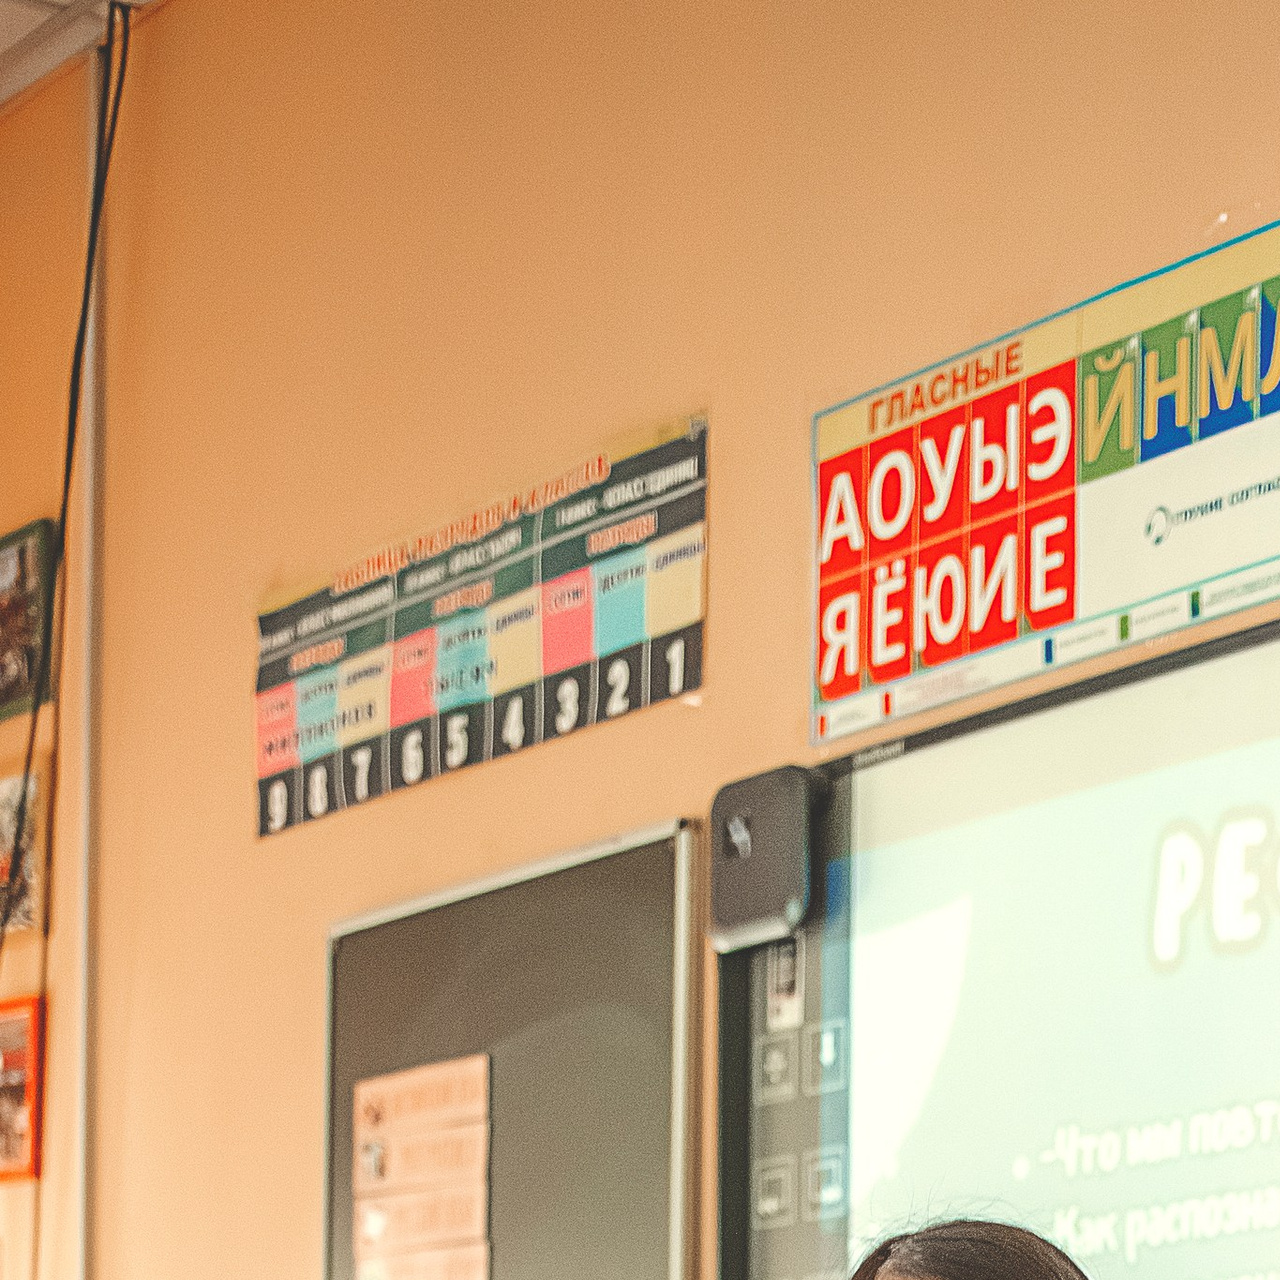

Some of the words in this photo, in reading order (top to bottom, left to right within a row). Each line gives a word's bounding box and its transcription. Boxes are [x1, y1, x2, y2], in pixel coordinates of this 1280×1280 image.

[867, 341, 1023, 434] ГЛАСНЫЕ
[351, 746, 372, 801] 7
[402, 729, 425, 784] 6
[447, 713, 469, 769] 5
[502, 696, 525, 751] 4
[555, 678, 580, 735] 3
[607, 658, 631, 717] 2
[666, 638, 685, 696] 1
